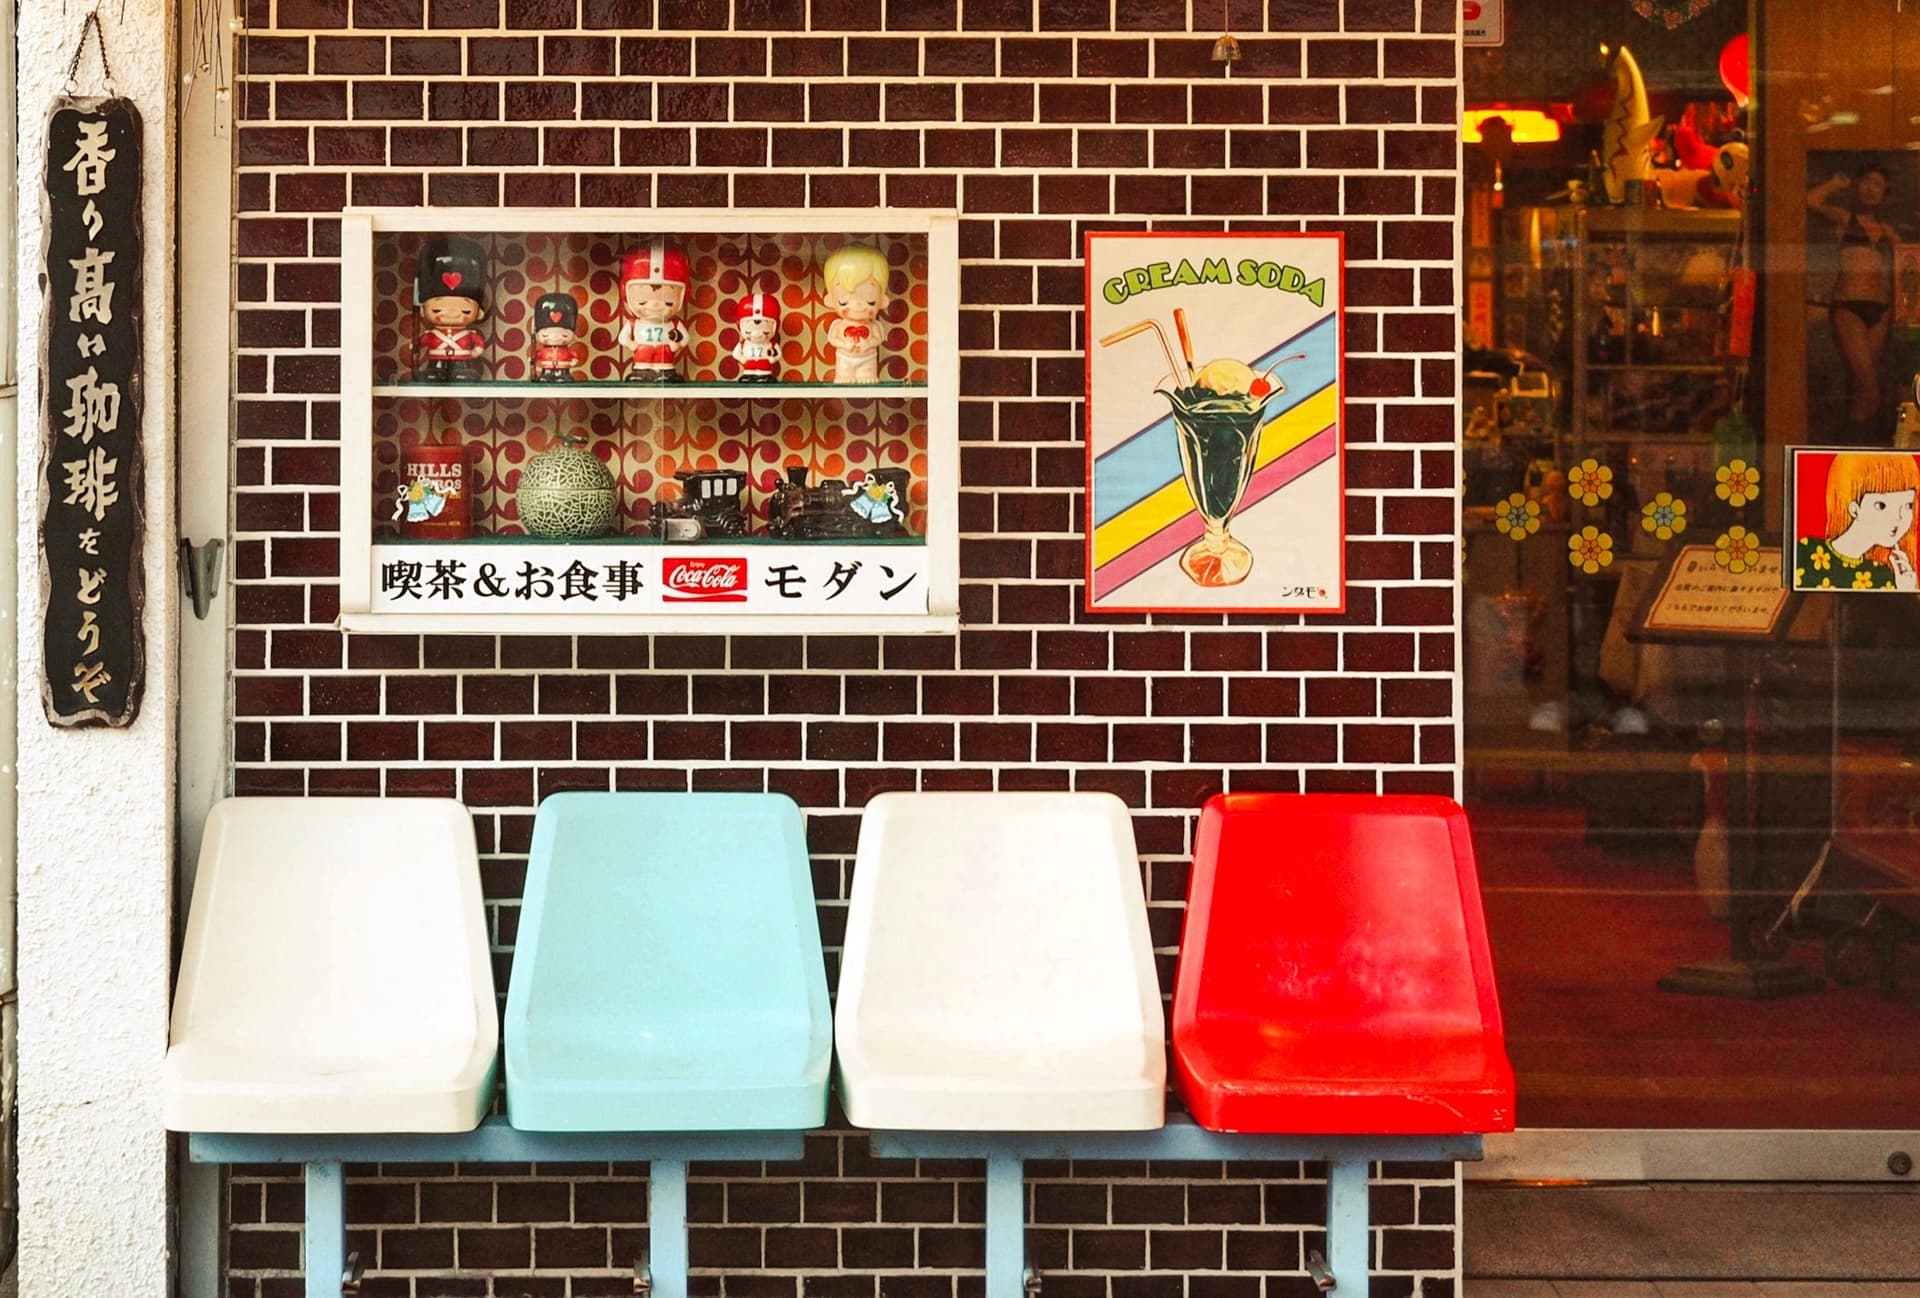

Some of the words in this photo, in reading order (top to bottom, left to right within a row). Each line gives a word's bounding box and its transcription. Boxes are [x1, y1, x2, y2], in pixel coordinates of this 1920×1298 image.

[1102, 257, 1232, 305] CREAM
[1236, 258, 1326, 308] SODA
[646, 327, 664, 342] 17
[407, 463, 462, 477] HILLS
[382, 560, 645, 602] 喫茶&お食事
[765, 561, 917, 600] モダン
